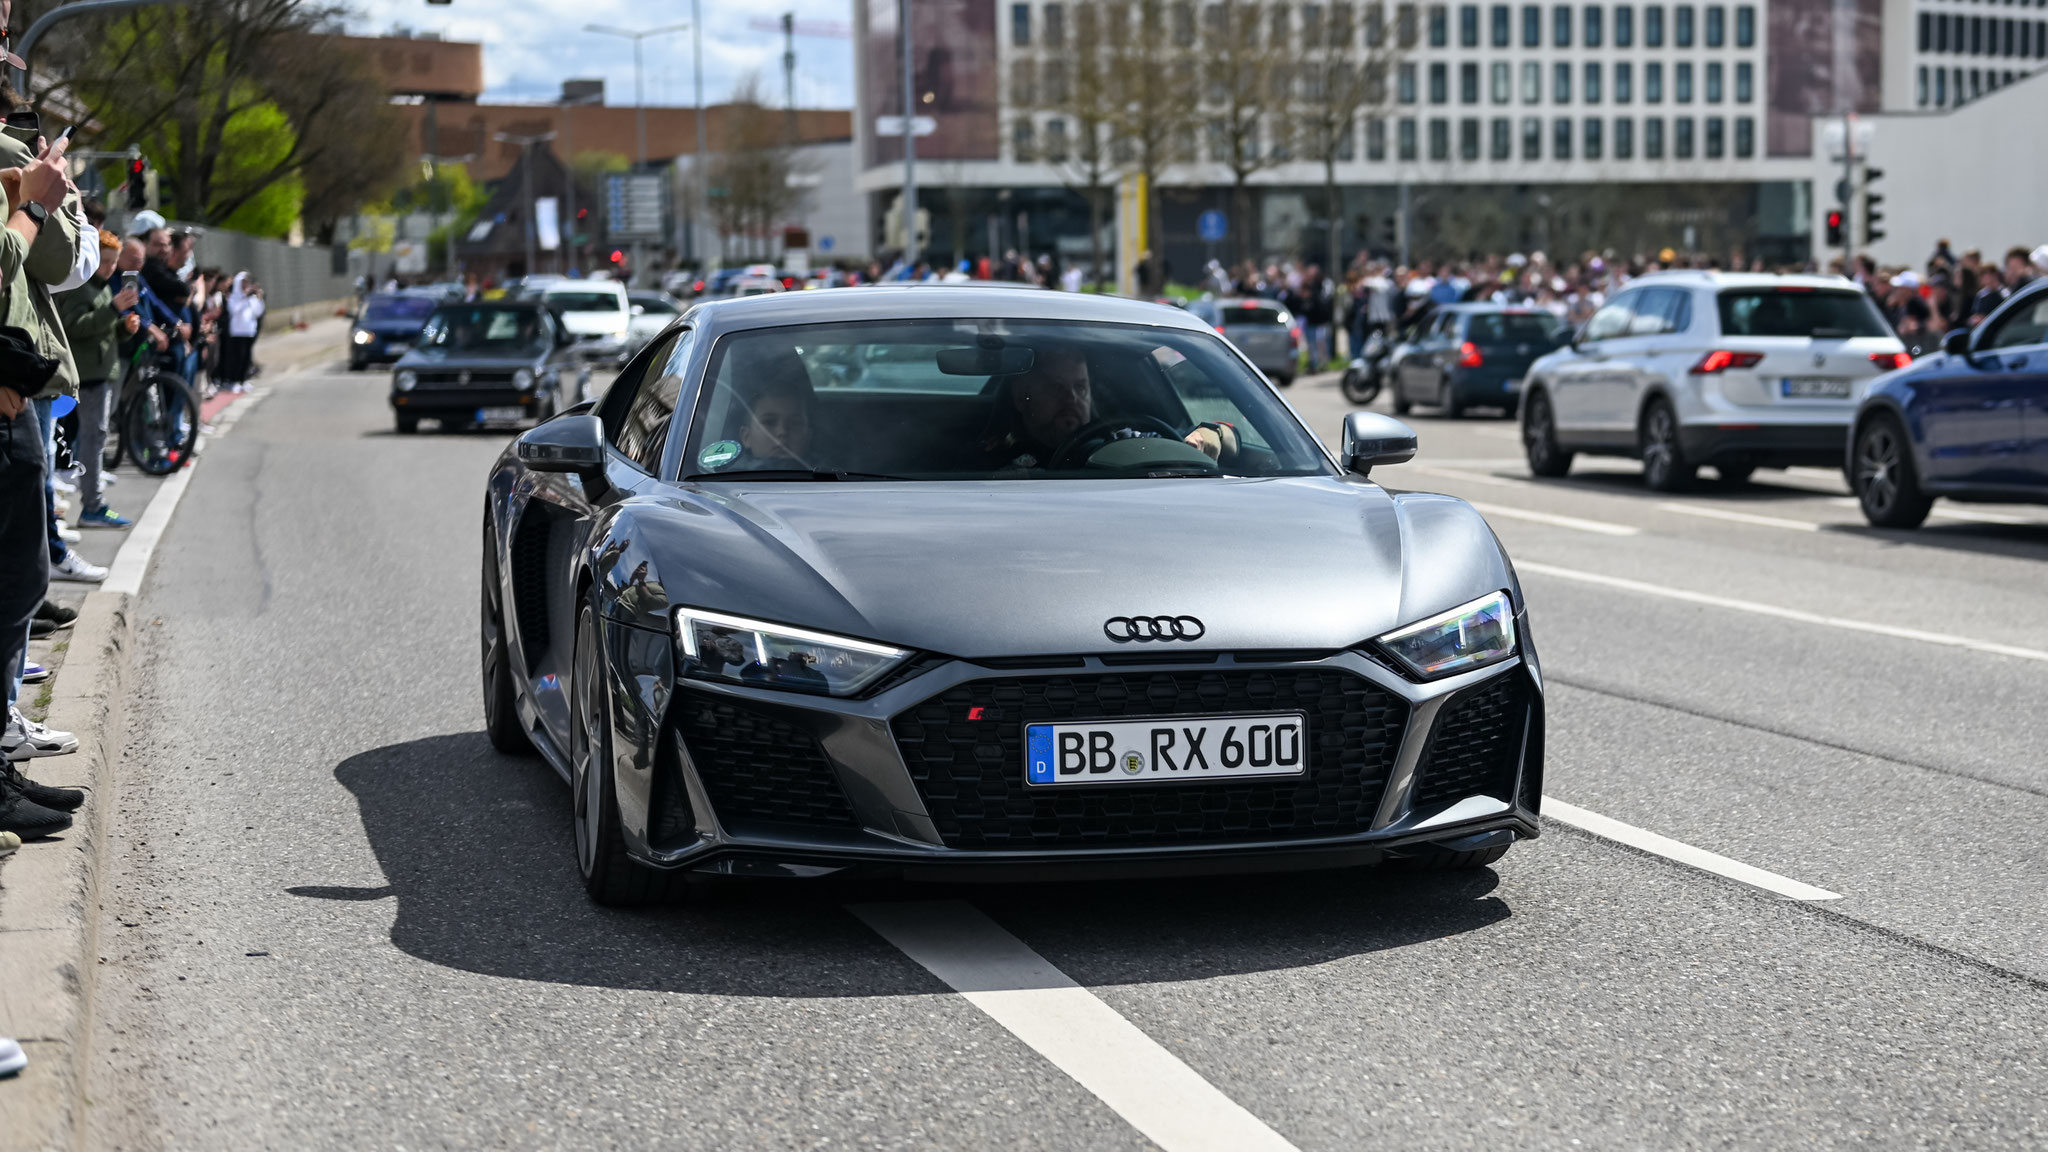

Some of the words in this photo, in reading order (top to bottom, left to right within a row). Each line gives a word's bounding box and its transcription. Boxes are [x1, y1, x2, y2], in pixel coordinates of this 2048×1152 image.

[715, 444, 725, 453] 4
[1059, 731, 1116, 775] BB
[1151, 727, 1209, 771] RX
[1220, 724, 1299, 769] 600
[1036, 761, 1046, 774] D
